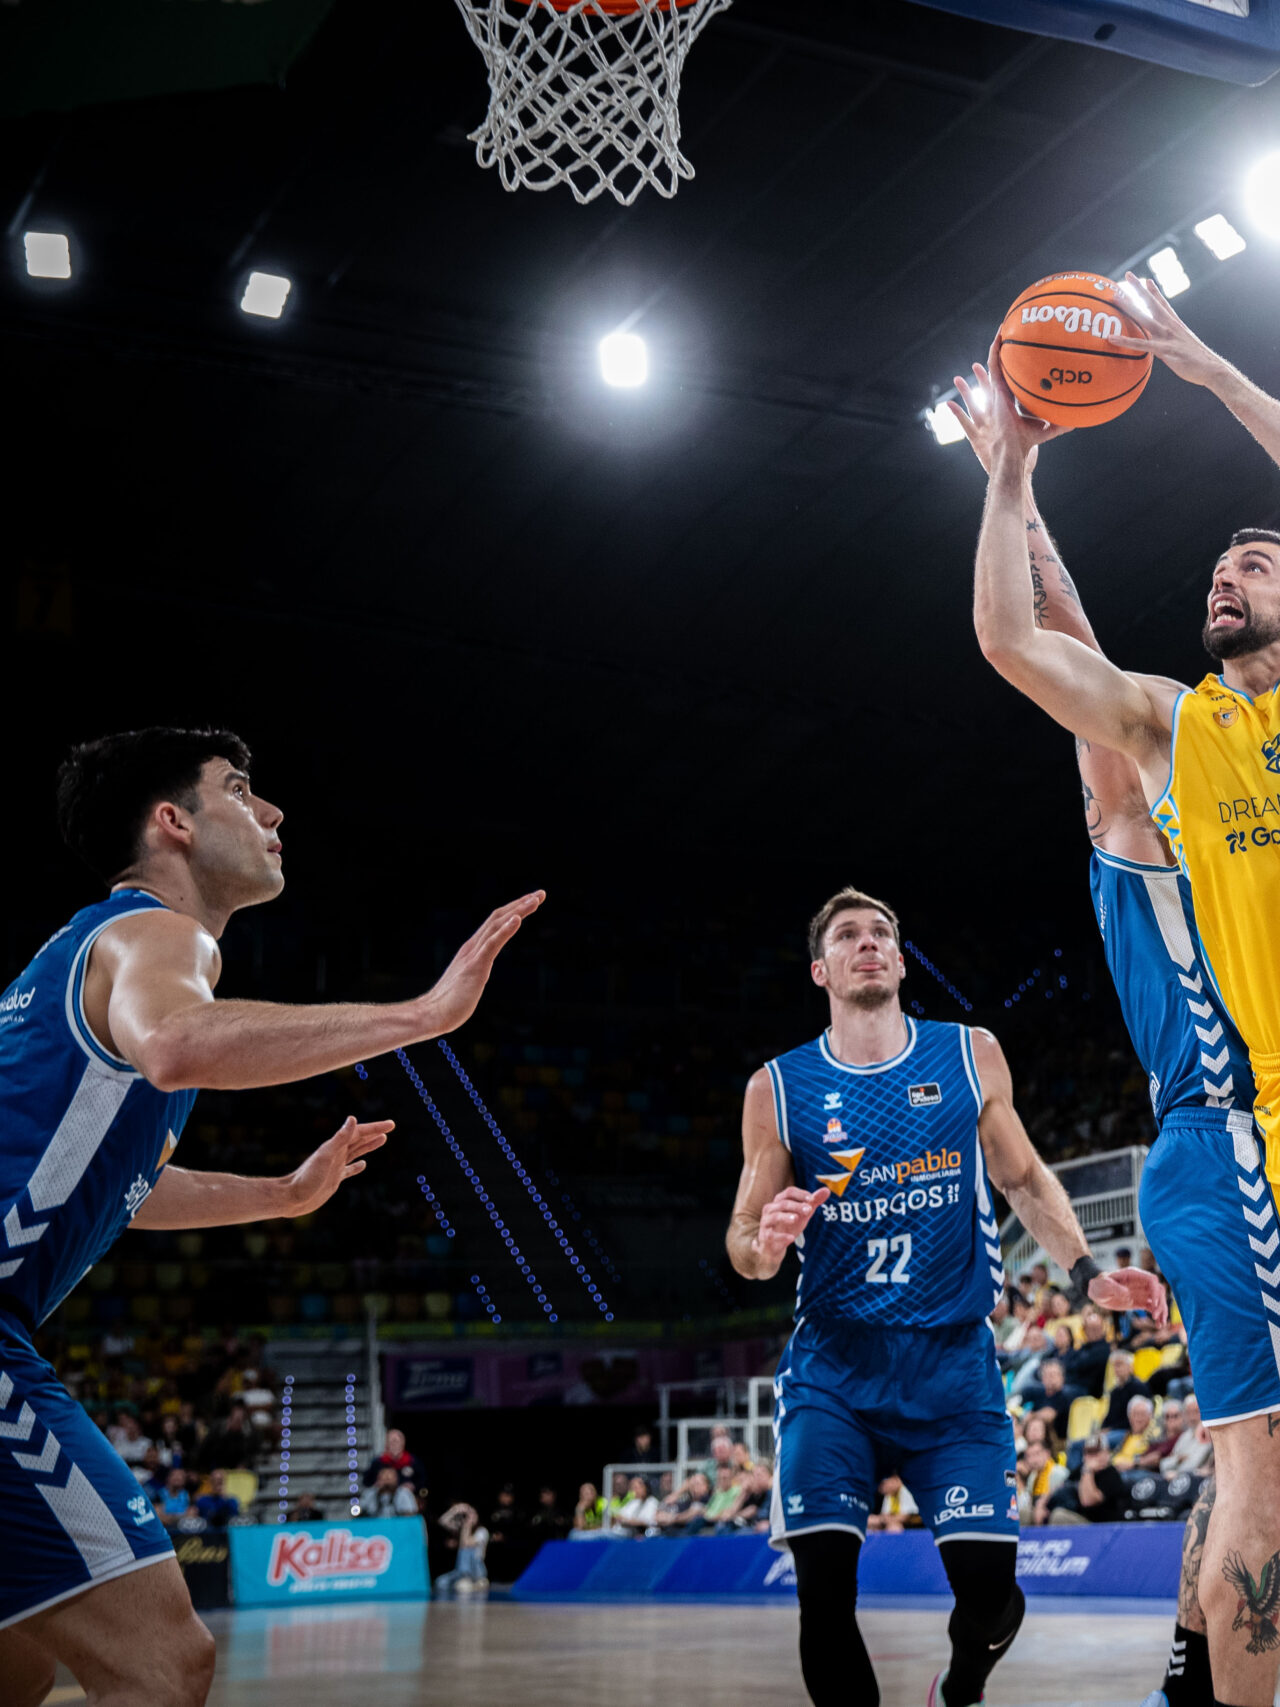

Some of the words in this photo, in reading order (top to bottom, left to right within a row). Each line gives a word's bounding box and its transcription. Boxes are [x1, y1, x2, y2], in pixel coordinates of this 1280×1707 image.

[1021, 305, 1123, 339] Wilson
[1049, 366, 1093, 385] acb
[910, 1168, 961, 1183] INMOBILIARIA
[838, 1185, 943, 1223] BURGOS
[864, 1233, 913, 1284] 22
[934, 1503, 995, 1526] LEXUS
